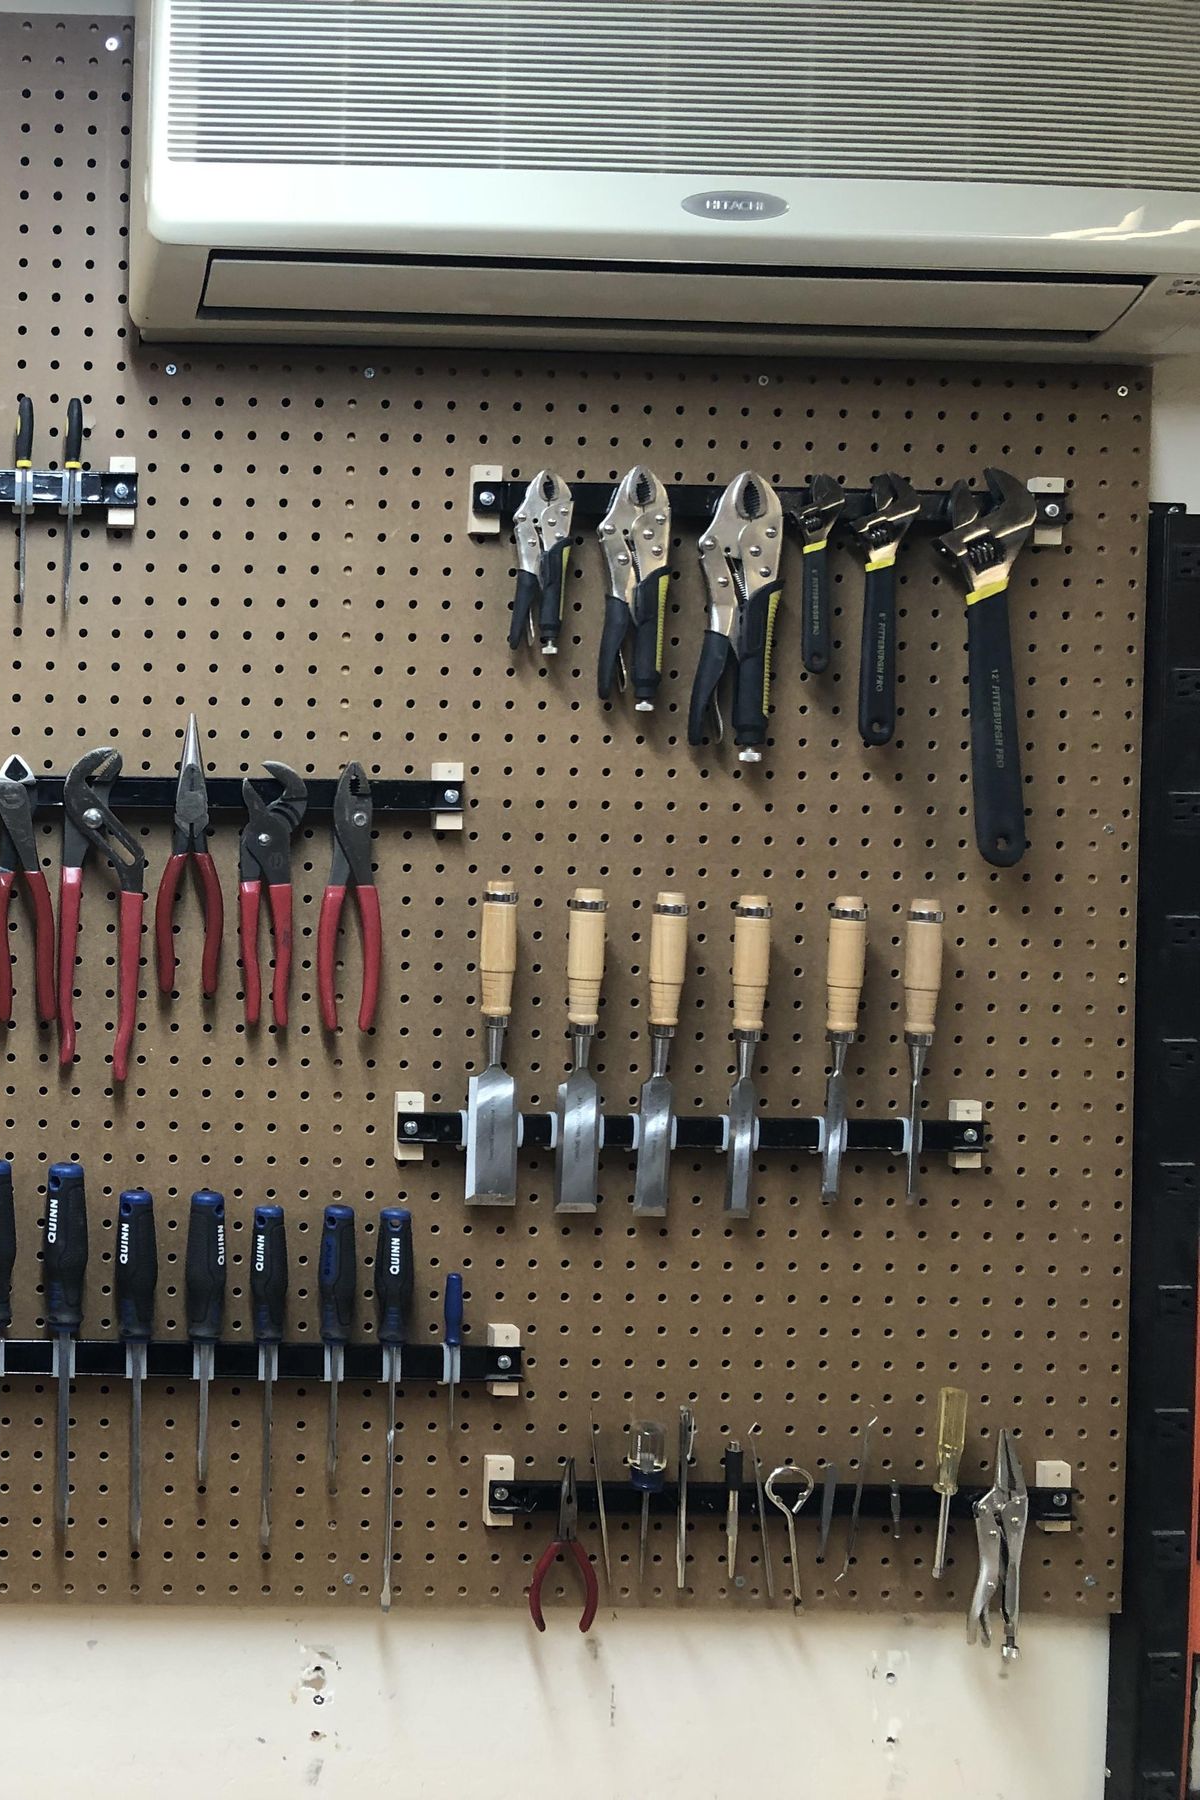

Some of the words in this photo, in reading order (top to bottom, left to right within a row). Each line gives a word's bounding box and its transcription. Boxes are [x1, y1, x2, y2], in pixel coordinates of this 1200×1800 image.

[706, 200, 764, 211] HITACHI
[992, 685, 1004, 746] PITTSBURGH
[995, 749, 1004, 768] PRO
[47, 1199, 59, 1244] QUINN
[119, 1223, 130, 1265] QUINN
[217, 1224, 225, 1266] QUINN
[255, 1234, 265, 1272] QUINN
[389, 1237, 400, 1275] QUINN
